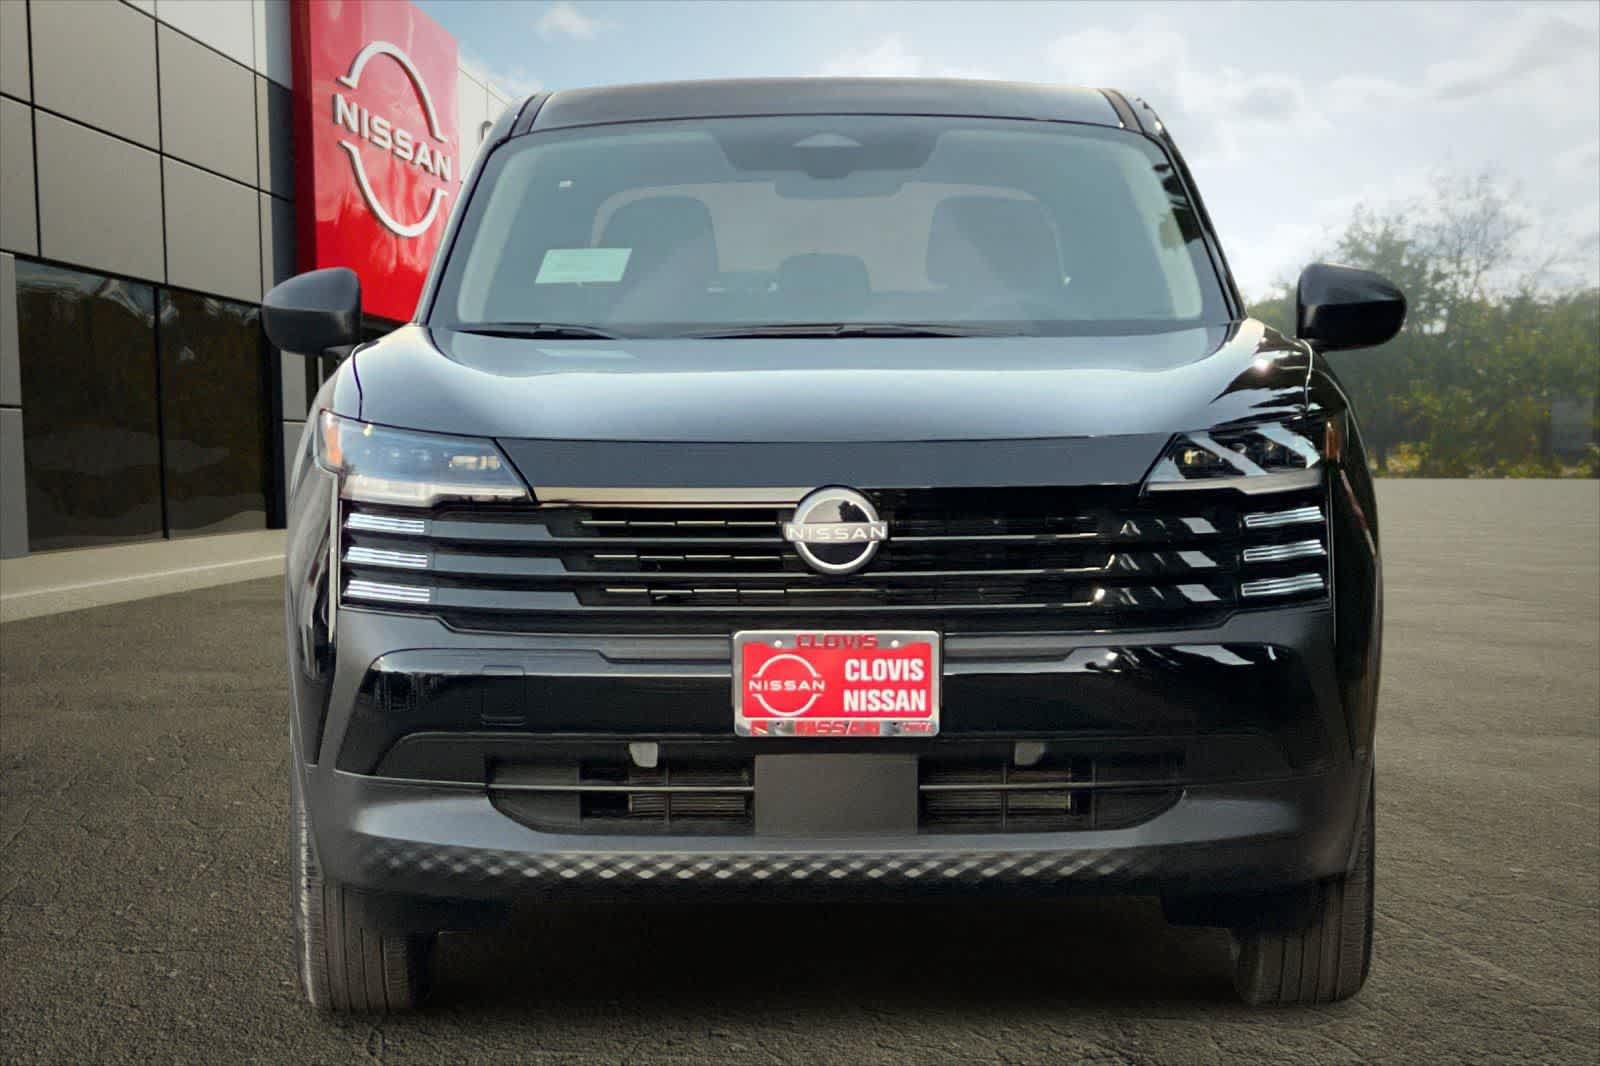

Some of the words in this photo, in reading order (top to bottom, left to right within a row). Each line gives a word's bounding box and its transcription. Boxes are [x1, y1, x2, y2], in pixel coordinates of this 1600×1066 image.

[333, 93, 450, 182] NISSAN
[787, 525, 886, 540] NISSAN
[795, 633, 878, 649] CLOVIS
[844, 658, 925, 682] CLOVIS
[749, 679, 825, 692] NISSAN
[843, 688, 927, 713] NISSAN
